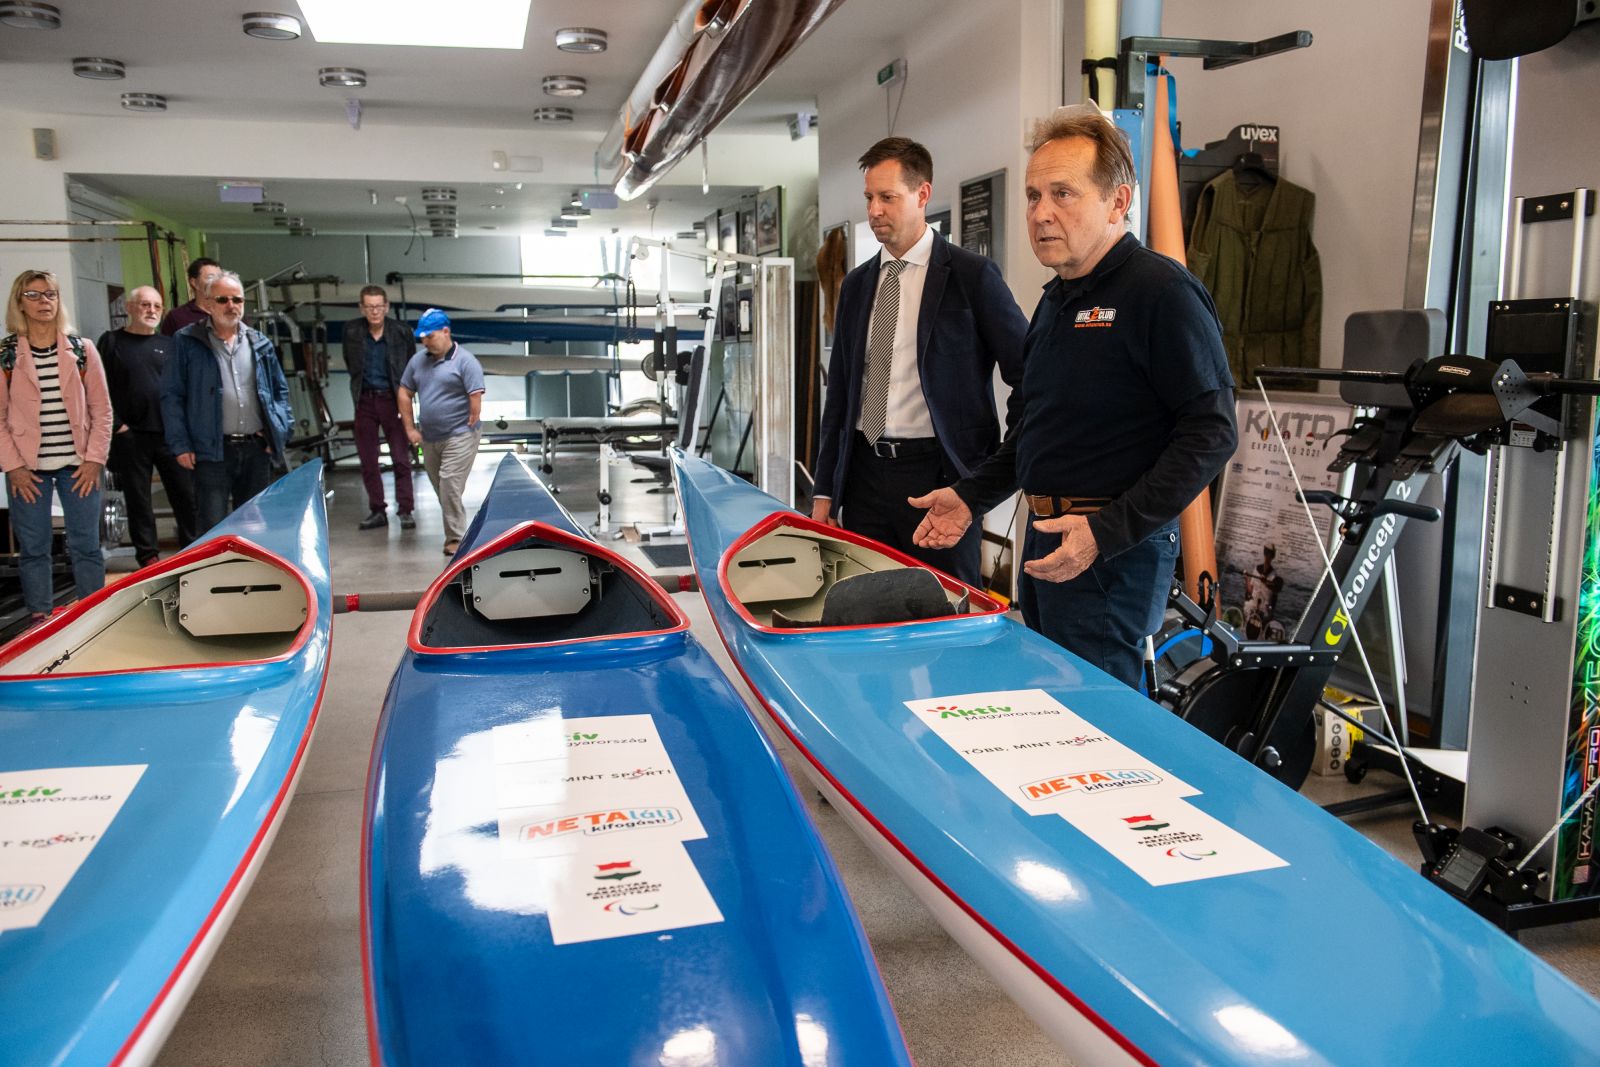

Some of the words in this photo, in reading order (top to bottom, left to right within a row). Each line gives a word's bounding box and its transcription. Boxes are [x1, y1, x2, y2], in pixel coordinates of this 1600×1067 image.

[1241, 126, 1277, 141] uvex
[1300, 448, 1321, 457] 2021
[940, 705, 1013, 718] Aktív
[965, 709, 1061, 722] Magyarország
[962, 745, 1009, 755] TÖBB,
[1013, 741, 1052, 751] MINT
